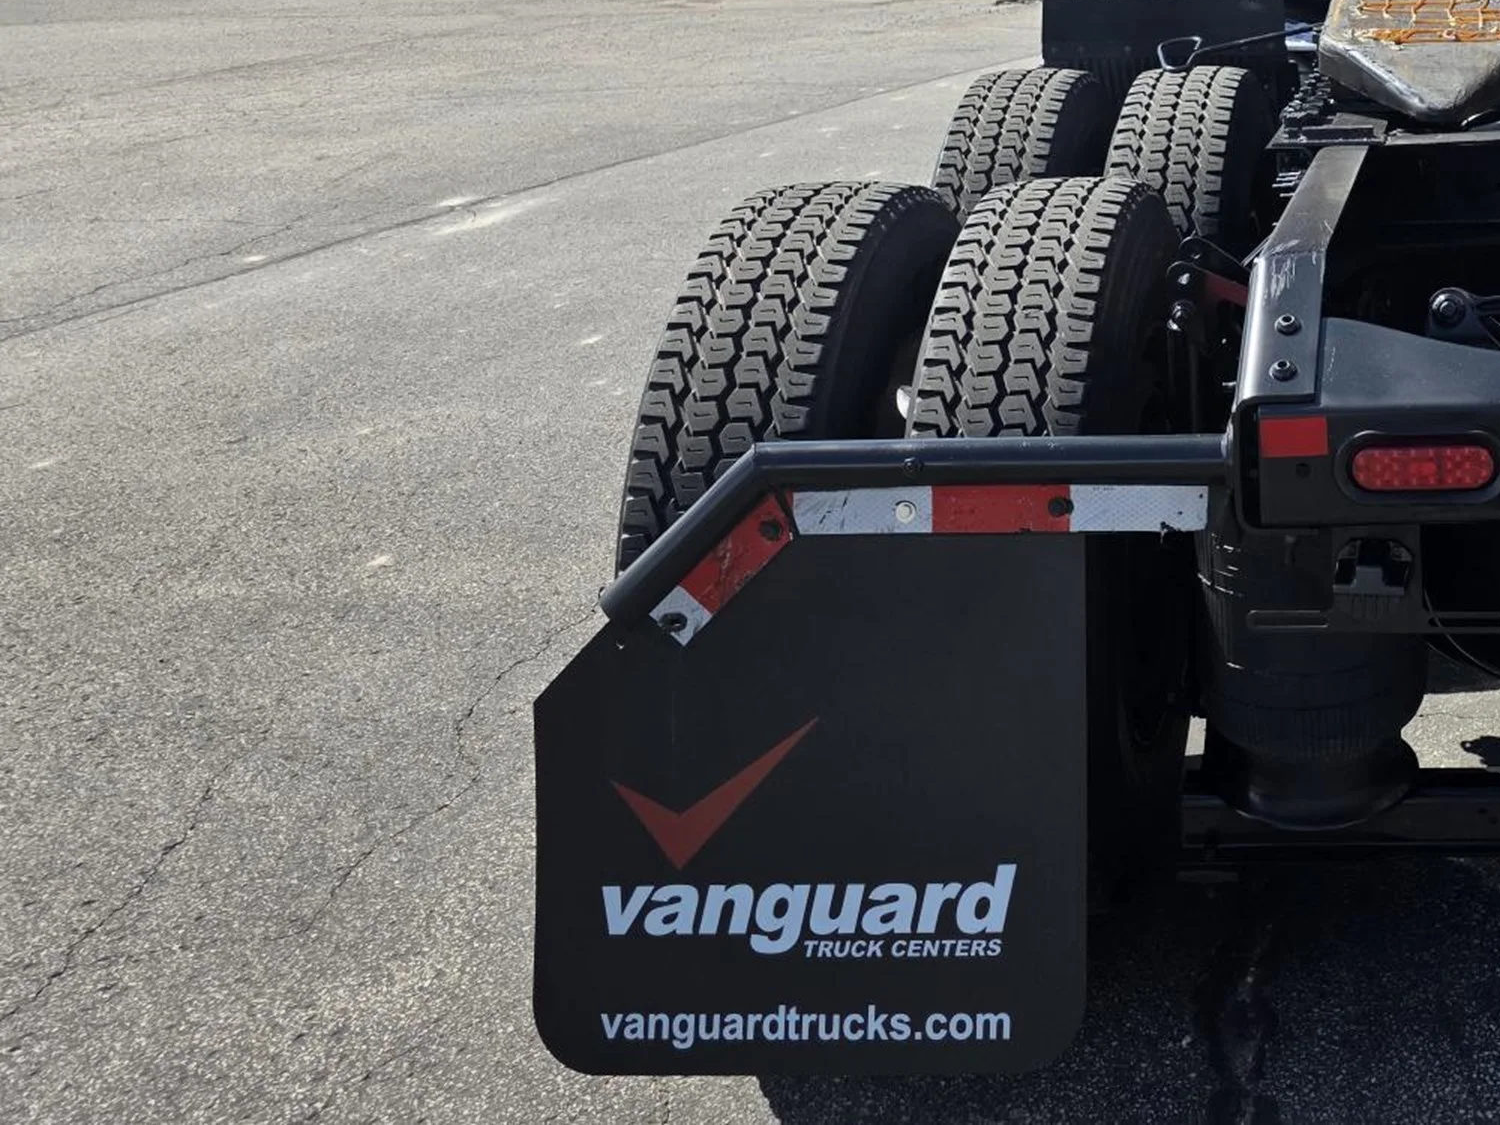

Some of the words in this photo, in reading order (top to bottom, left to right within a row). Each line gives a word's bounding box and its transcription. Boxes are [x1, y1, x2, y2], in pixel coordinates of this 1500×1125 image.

[601, 864, 1017, 955] vanguard
[803, 940, 884, 958] TRUCK
[891, 939, 1002, 957] CENTERS
[600, 1005, 1011, 1050] vanguardtrucks.com
